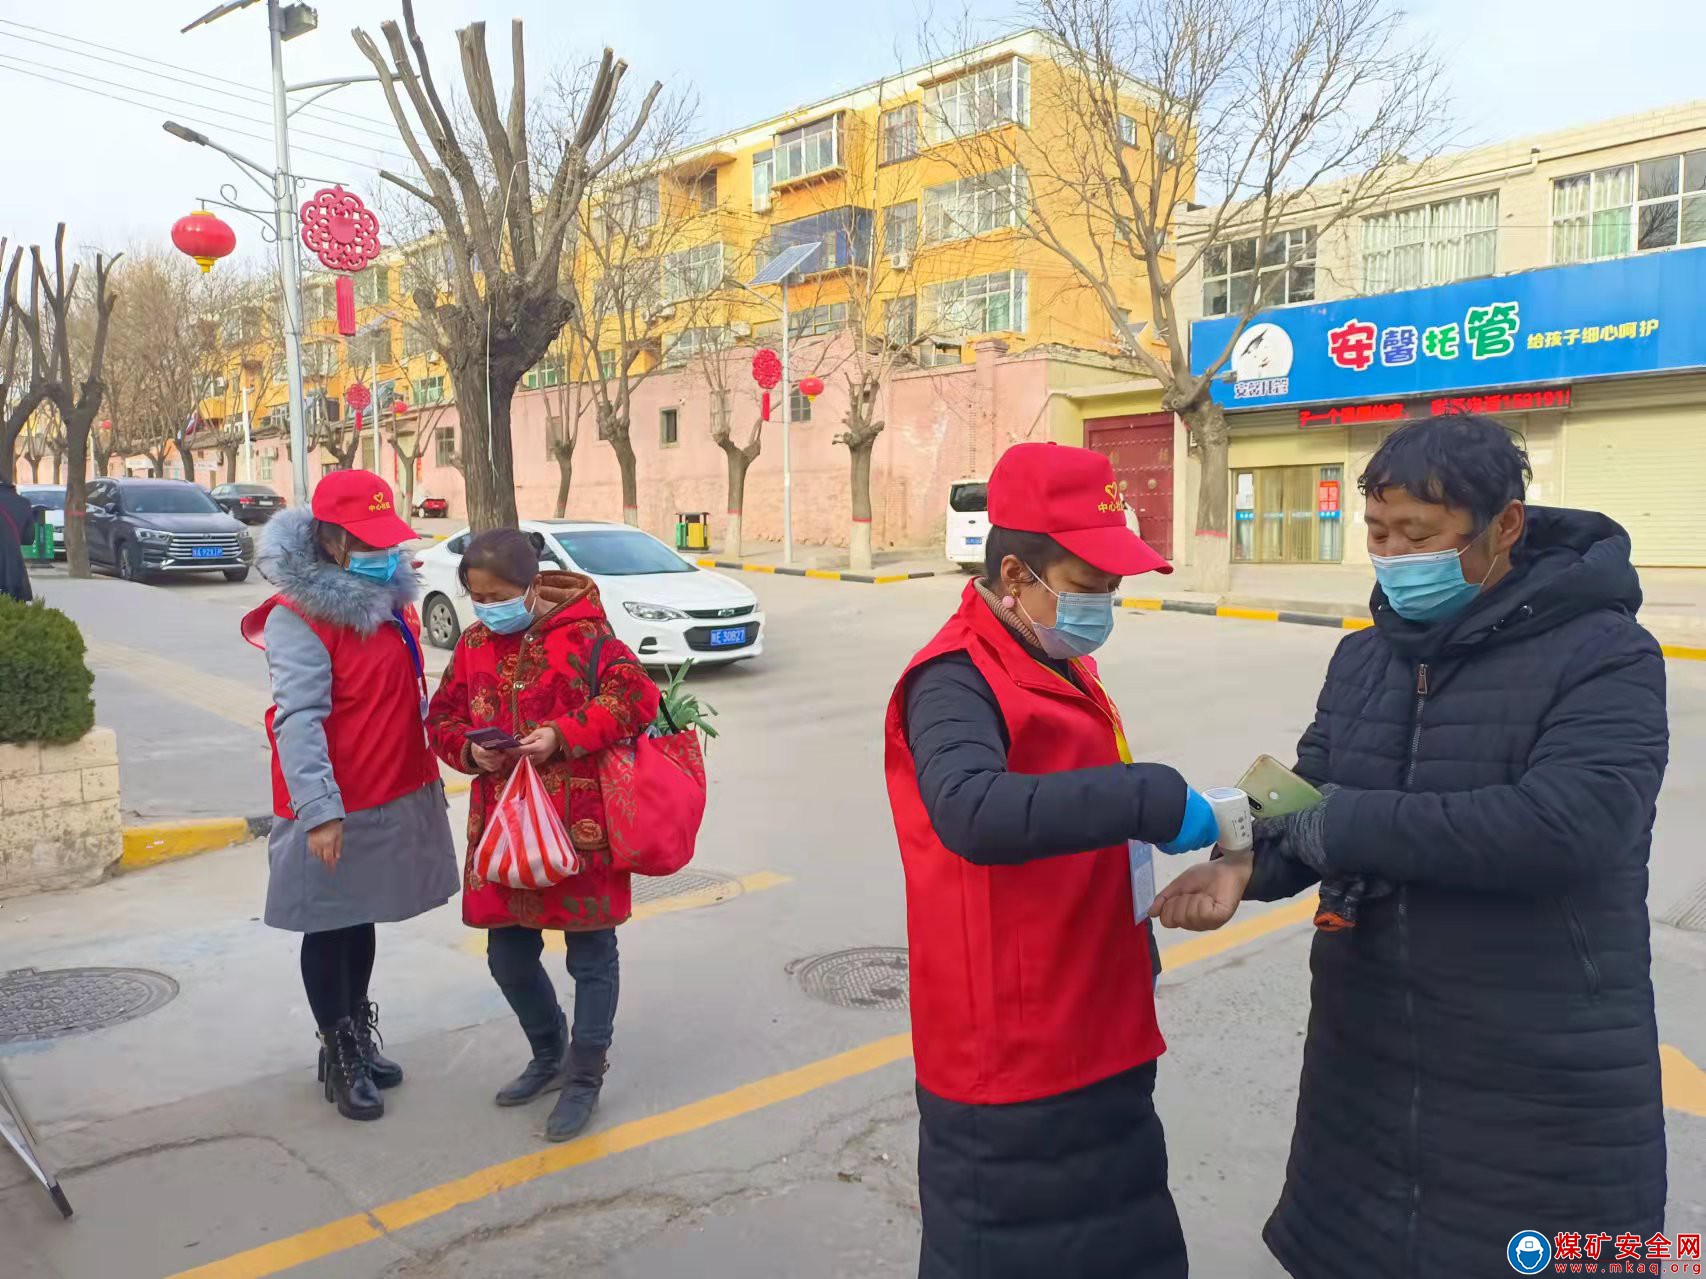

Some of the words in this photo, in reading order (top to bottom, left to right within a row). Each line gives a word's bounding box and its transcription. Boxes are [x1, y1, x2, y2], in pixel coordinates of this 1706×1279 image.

[1329, 302, 1519, 370] 安馨托管
[1527, 319, 1659, 350] 给孩子细心呵护
